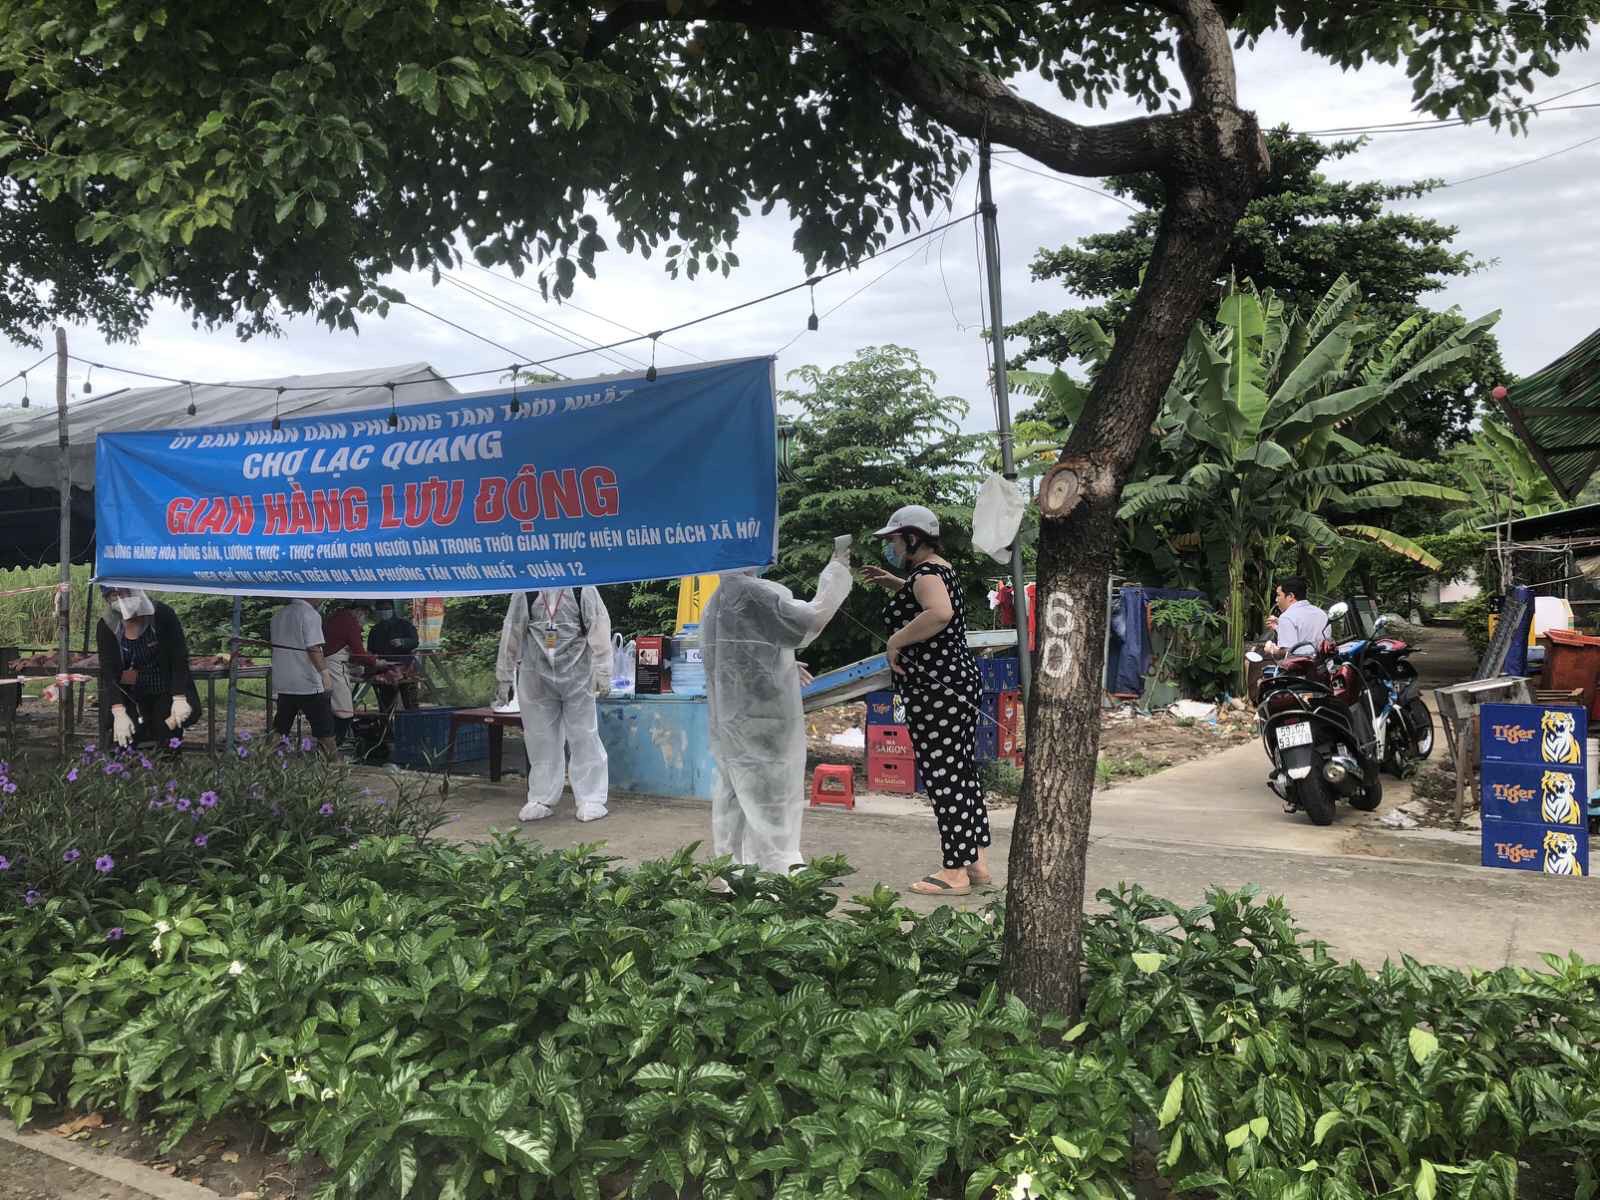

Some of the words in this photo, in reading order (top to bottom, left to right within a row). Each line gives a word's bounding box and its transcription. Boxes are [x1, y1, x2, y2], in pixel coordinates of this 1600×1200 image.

[198, 431, 240, 449] BAN
[304, 422, 347, 442] DÂN
[447, 406, 495, 428] TÂN
[242, 447, 308, 482] CHỢ
[310, 444, 375, 479] LẠC
[381, 429, 504, 470] QUANG
[166, 495, 256, 536] GIAN
[263, 481, 369, 536] HÀNG
[380, 475, 465, 530] LƯU
[473, 463, 620, 533] ĐỘNG
[254, 543, 280, 564] THỰC
[289, 543, 315, 564] THỰC
[316, 537, 349, 560] PHẨM
[350, 542, 374, 559] CHO
[374, 536, 410, 558] NGƯỜI
[413, 535, 439, 556] DÂN
[440, 536, 483, 555] TRONG
[484, 532, 514, 553] THỜI
[516, 533, 550, 552] GIAN
[552, 530, 587, 553] THỰC
[589, 526, 623, 552] HIỆN
[626, 524, 662, 547] GIÃN
[664, 521, 707, 545] CÁCH
[708, 518, 734, 541] XÃ
[736, 516, 762, 543] HỘI
[300, 566, 333, 583] TRÊN
[350, 566, 377, 583] BÀN
[375, 563, 427, 582] PHƯỜNG
[424, 563, 453, 582] TÂN
[480, 558, 518, 579] NHẤT
[527, 560, 566, 581] QUẬN
[567, 561, 587, 577] 12
[1492, 723, 1536, 745] Tiger
[1492, 782, 1537, 805] Tiger
[1493, 841, 1538, 864] Tiger
